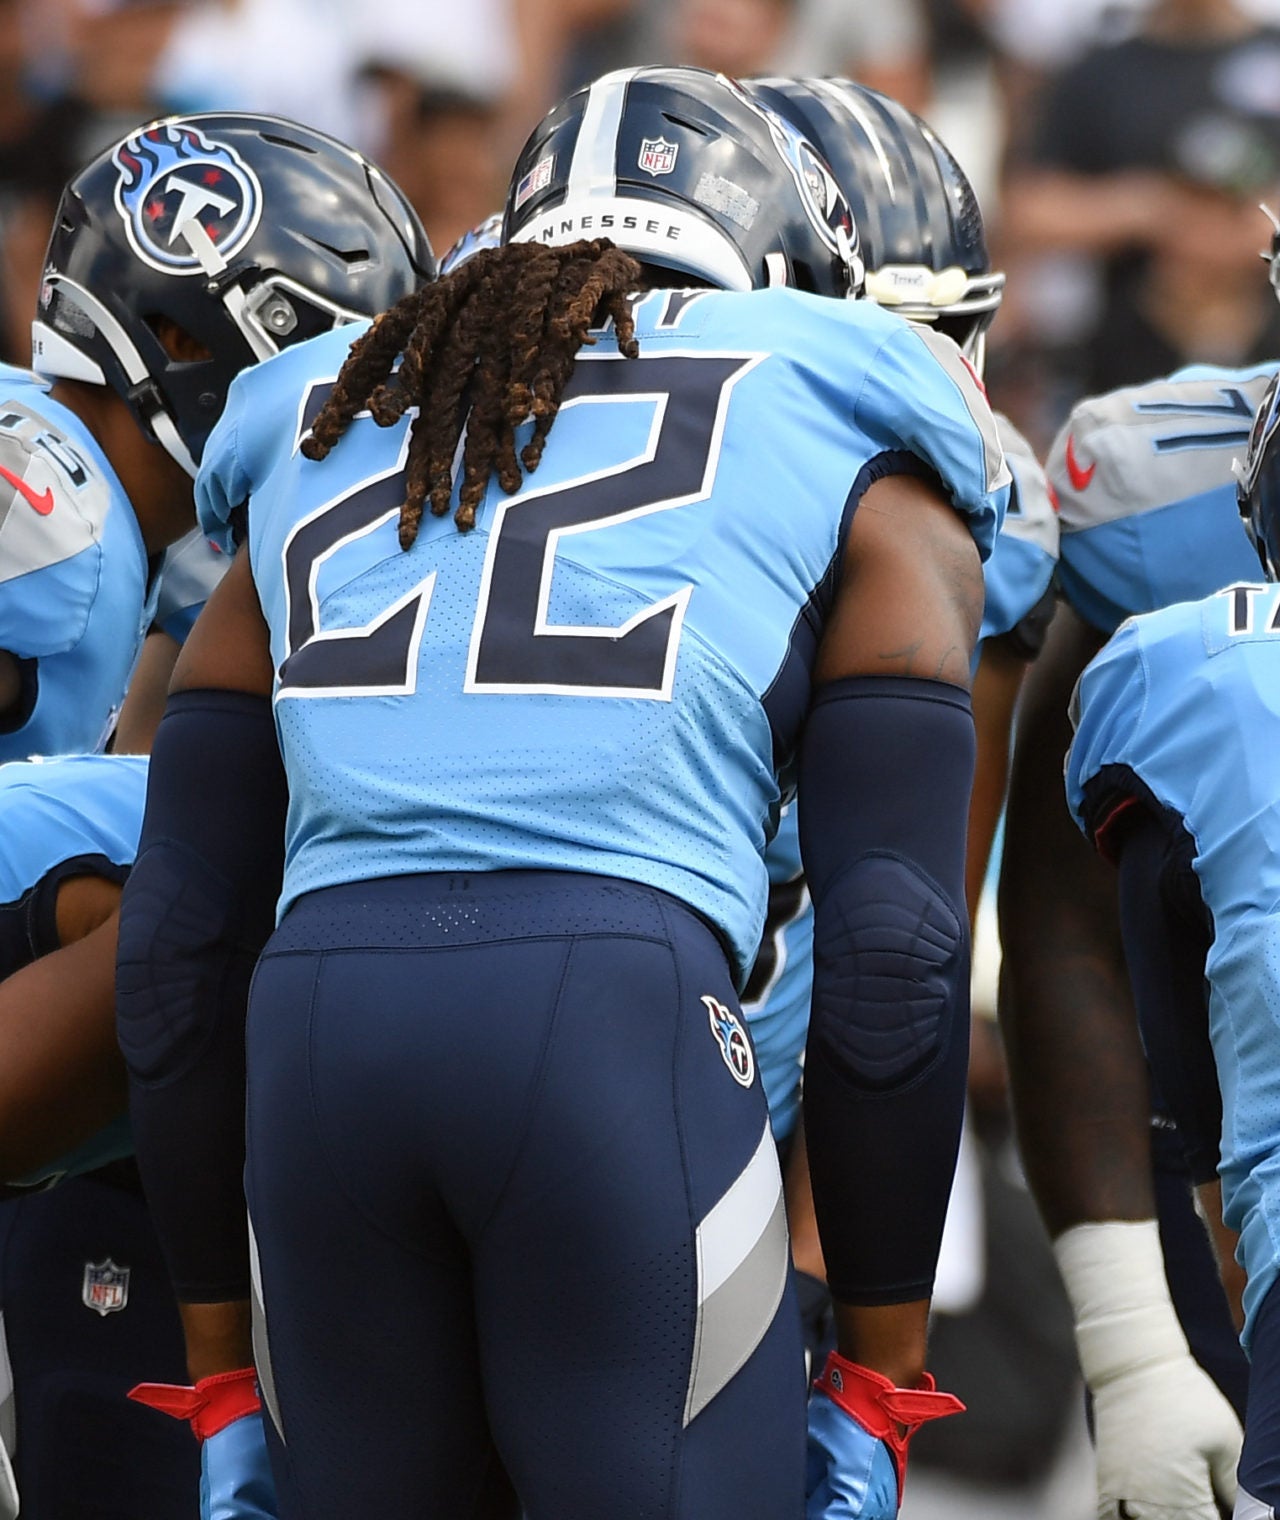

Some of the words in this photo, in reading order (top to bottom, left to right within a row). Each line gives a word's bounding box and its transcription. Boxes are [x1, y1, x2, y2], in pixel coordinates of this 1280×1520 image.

[644, 153, 670, 170] NFL
[273, 350, 772, 703] 22
[92, 1283, 122, 1306] NFL
